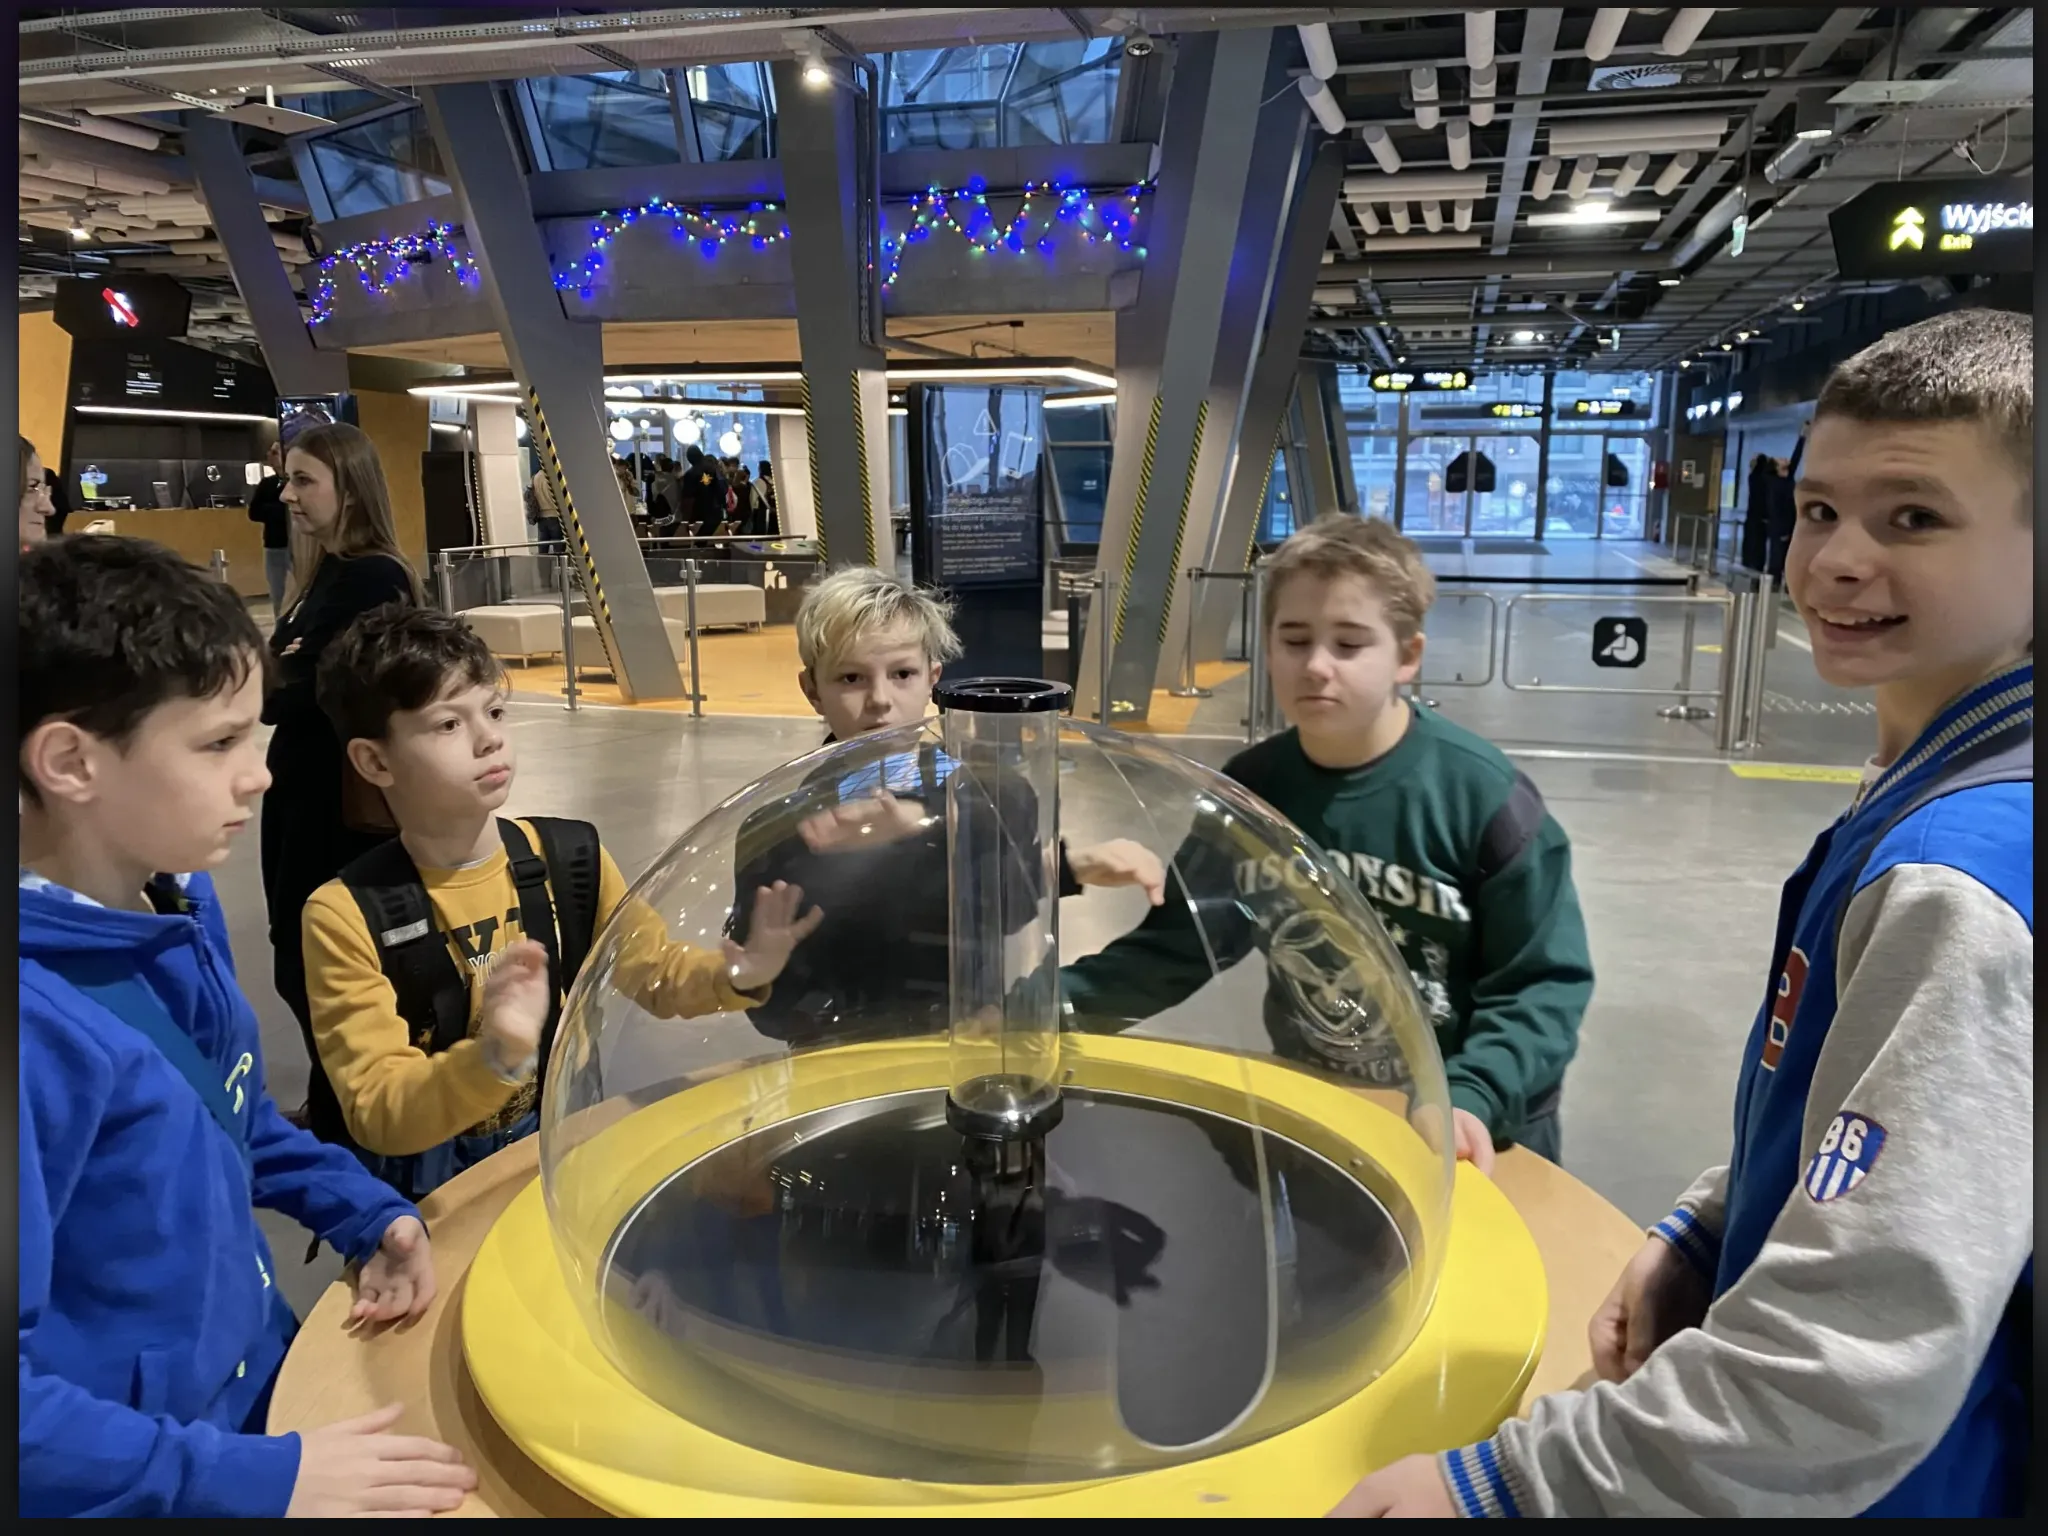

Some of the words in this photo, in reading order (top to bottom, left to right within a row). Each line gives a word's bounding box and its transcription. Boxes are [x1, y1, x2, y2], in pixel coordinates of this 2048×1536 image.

[1940, 234, 1973, 250] Exit
[1234, 850, 1471, 921] ISCONSIN
[1819, 1116, 1868, 1161] 86
